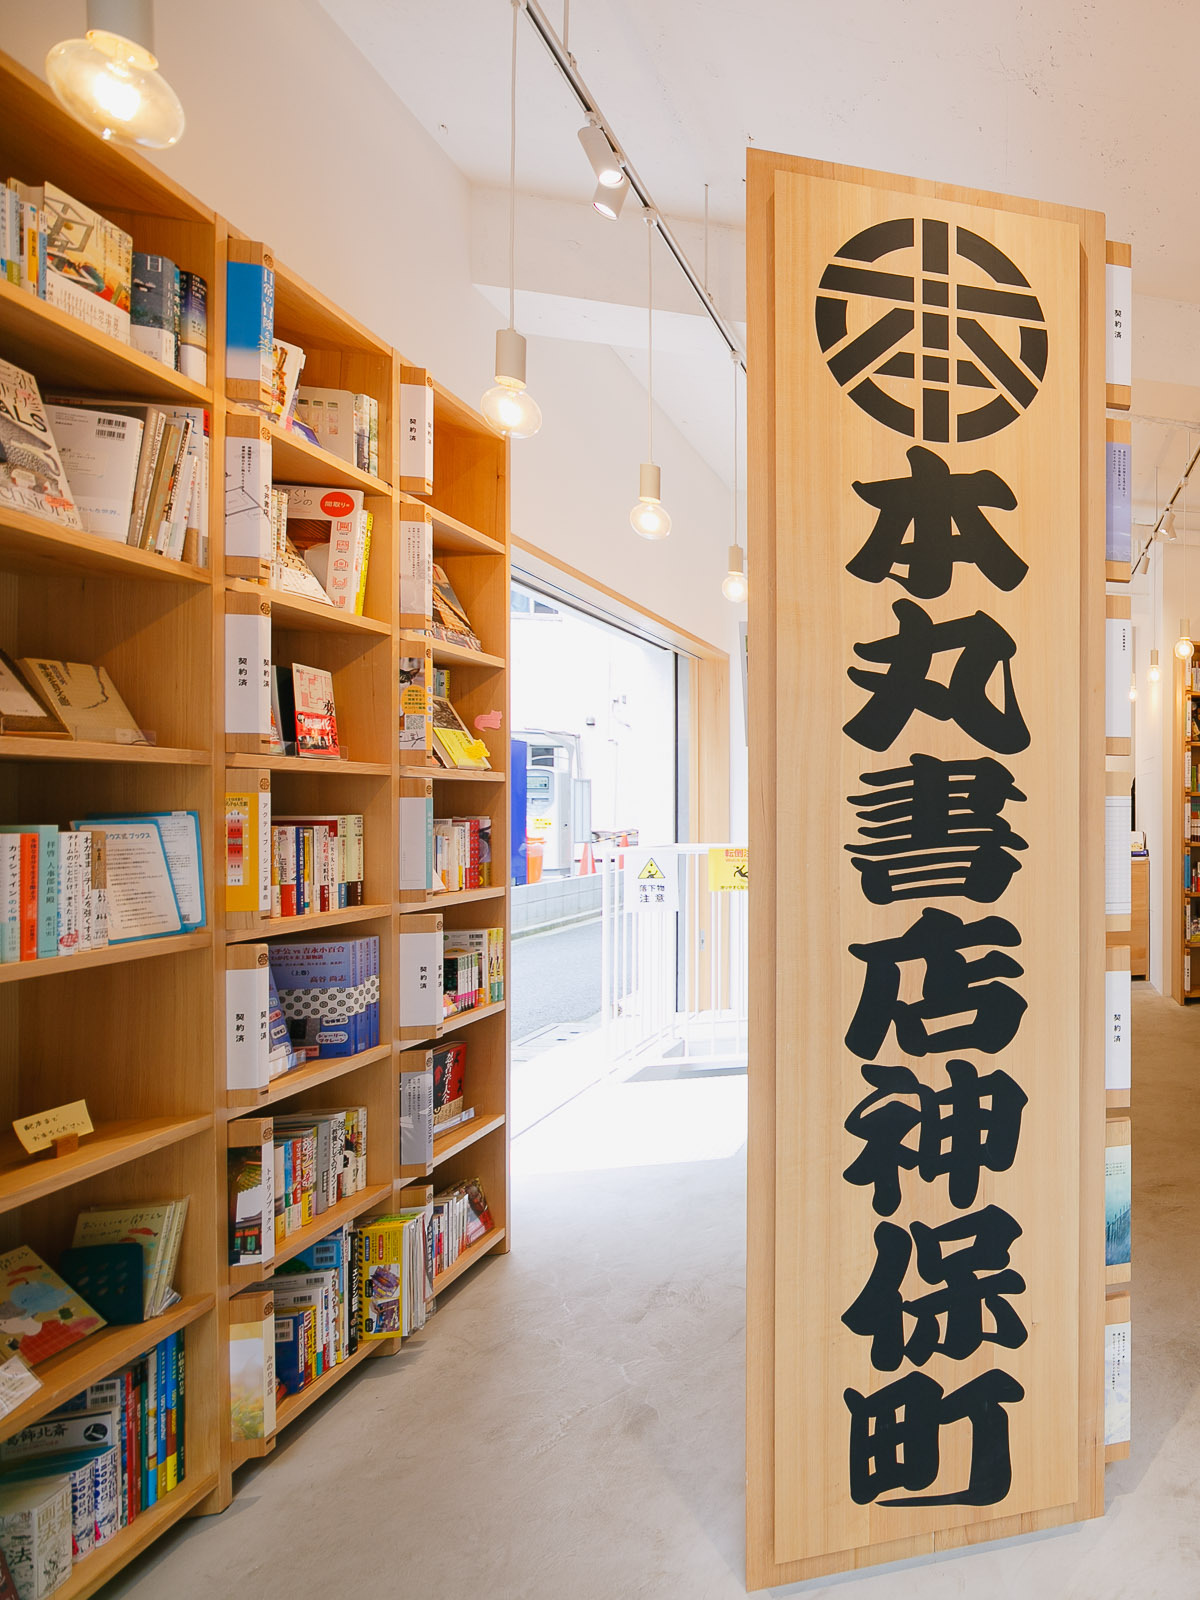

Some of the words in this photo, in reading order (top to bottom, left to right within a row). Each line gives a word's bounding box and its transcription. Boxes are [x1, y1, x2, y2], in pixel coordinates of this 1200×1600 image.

[408, 418, 416, 442] 契約済
[238, 656, 248, 687] 契約済
[640, 894, 664, 902] 注意
[420, 966, 428, 990] 契約済
[841, 445, 1030, 1508] 本丸書店神保町
[235, 1013, 245, 1043] 契約済
[1114, 1014, 1122, 1044] 契約済
